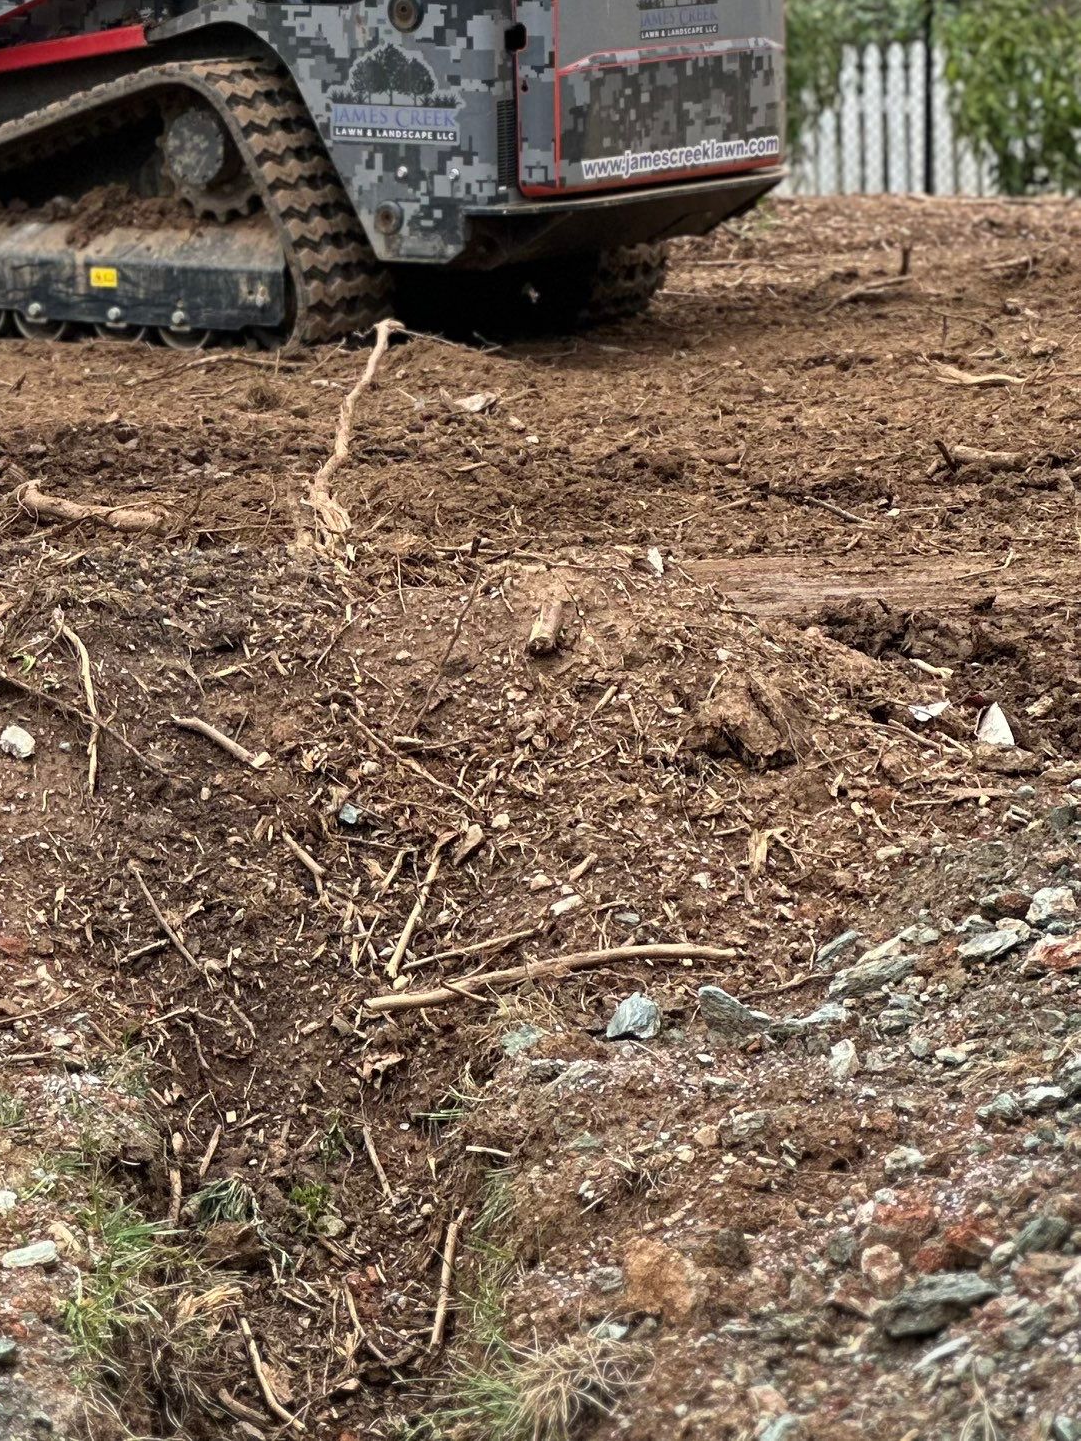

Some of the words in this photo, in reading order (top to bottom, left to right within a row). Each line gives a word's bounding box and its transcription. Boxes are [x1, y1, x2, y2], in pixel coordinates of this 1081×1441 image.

[641, 10, 676, 28] JAMES
[679, 8, 718, 26] CREEK
[641, 30, 660, 39] LAWN
[667, 26, 703, 37] LANDSCAPE
[705, 25, 717, 33] LLC
[334, 106, 389, 125] JAMES
[395, 108, 456, 128] CREEK
[335, 127, 363, 136] LAWN
[366, 128, 373, 137] &
[376, 129, 433, 139] LANDSCAPE
[437, 132, 455, 140] LLC
[583, 137, 779, 177] www.jamescreeklawn.com
